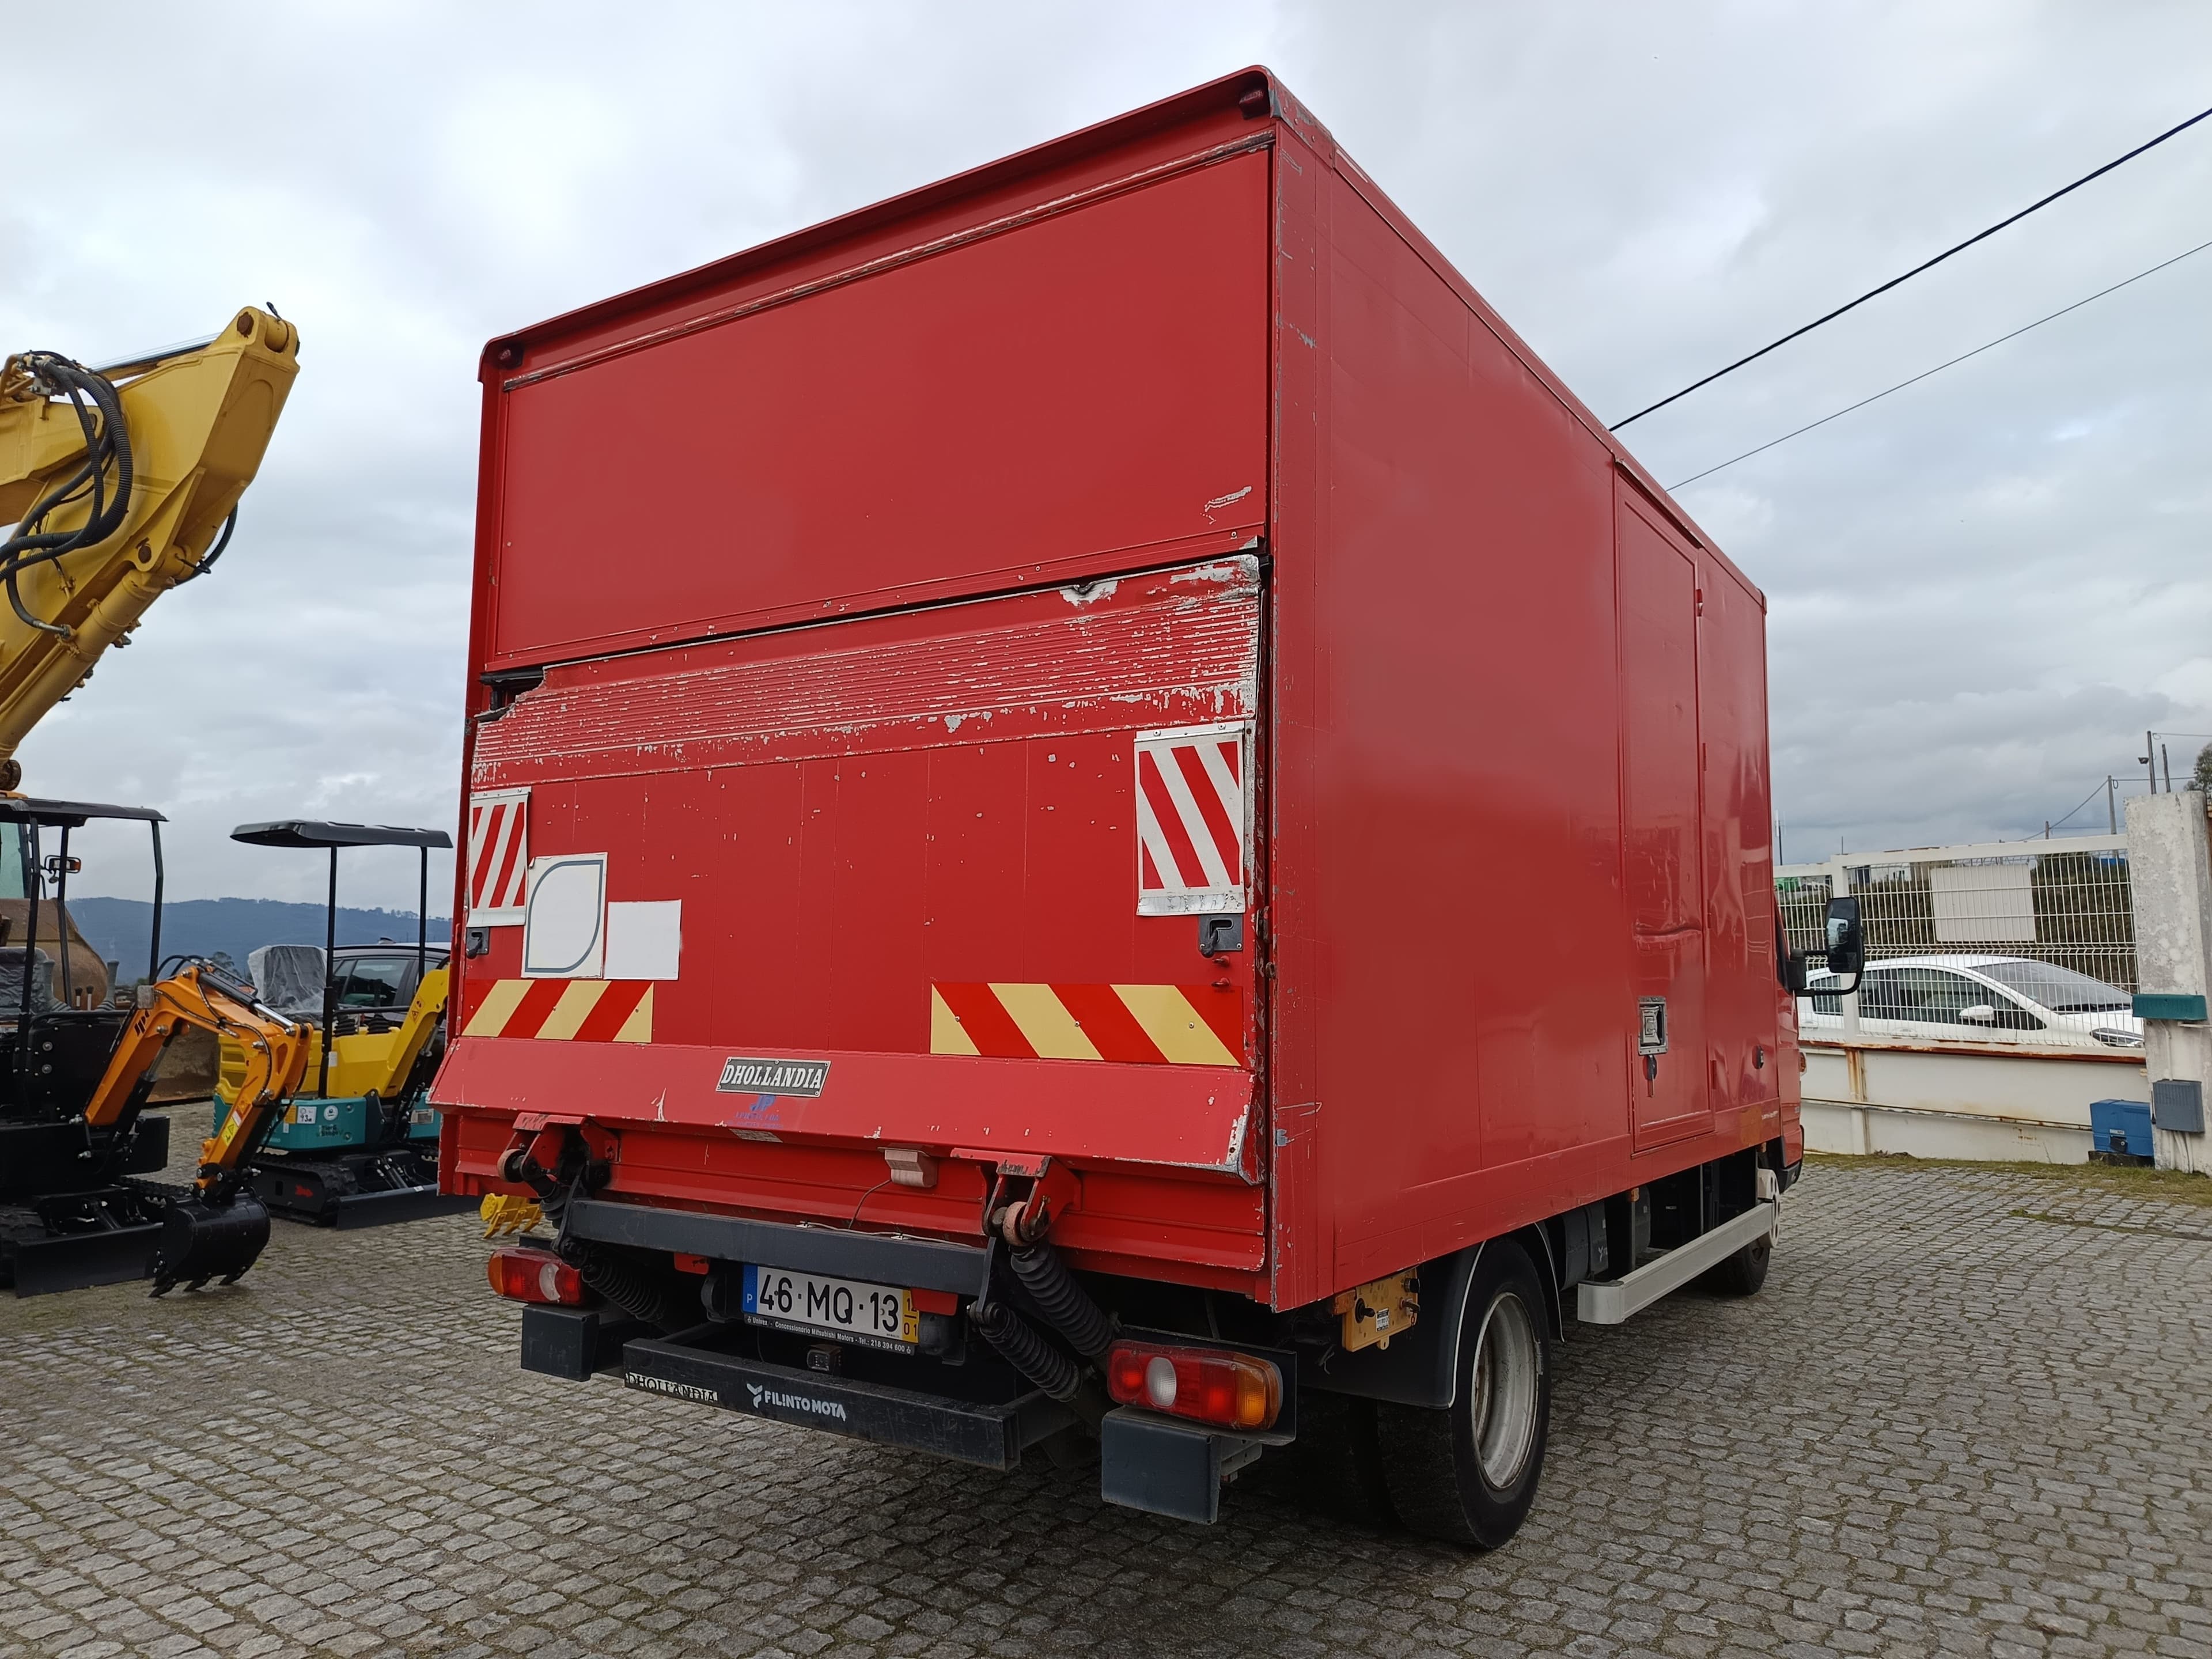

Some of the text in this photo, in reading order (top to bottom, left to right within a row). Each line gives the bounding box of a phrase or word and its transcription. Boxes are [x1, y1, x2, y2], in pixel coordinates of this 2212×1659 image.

[721, 1065, 823, 1089] DHOLLANDIA
[747, 1294, 752, 1303] P
[752, 1317, 768, 1325] Univex
[812, 1328, 836, 1339] Mitsubishi
[837, 1333, 854, 1343] Motors
[870, 1339, 881, 1347] 218
[764, 1390, 846, 1421] FILINTO MOTA
